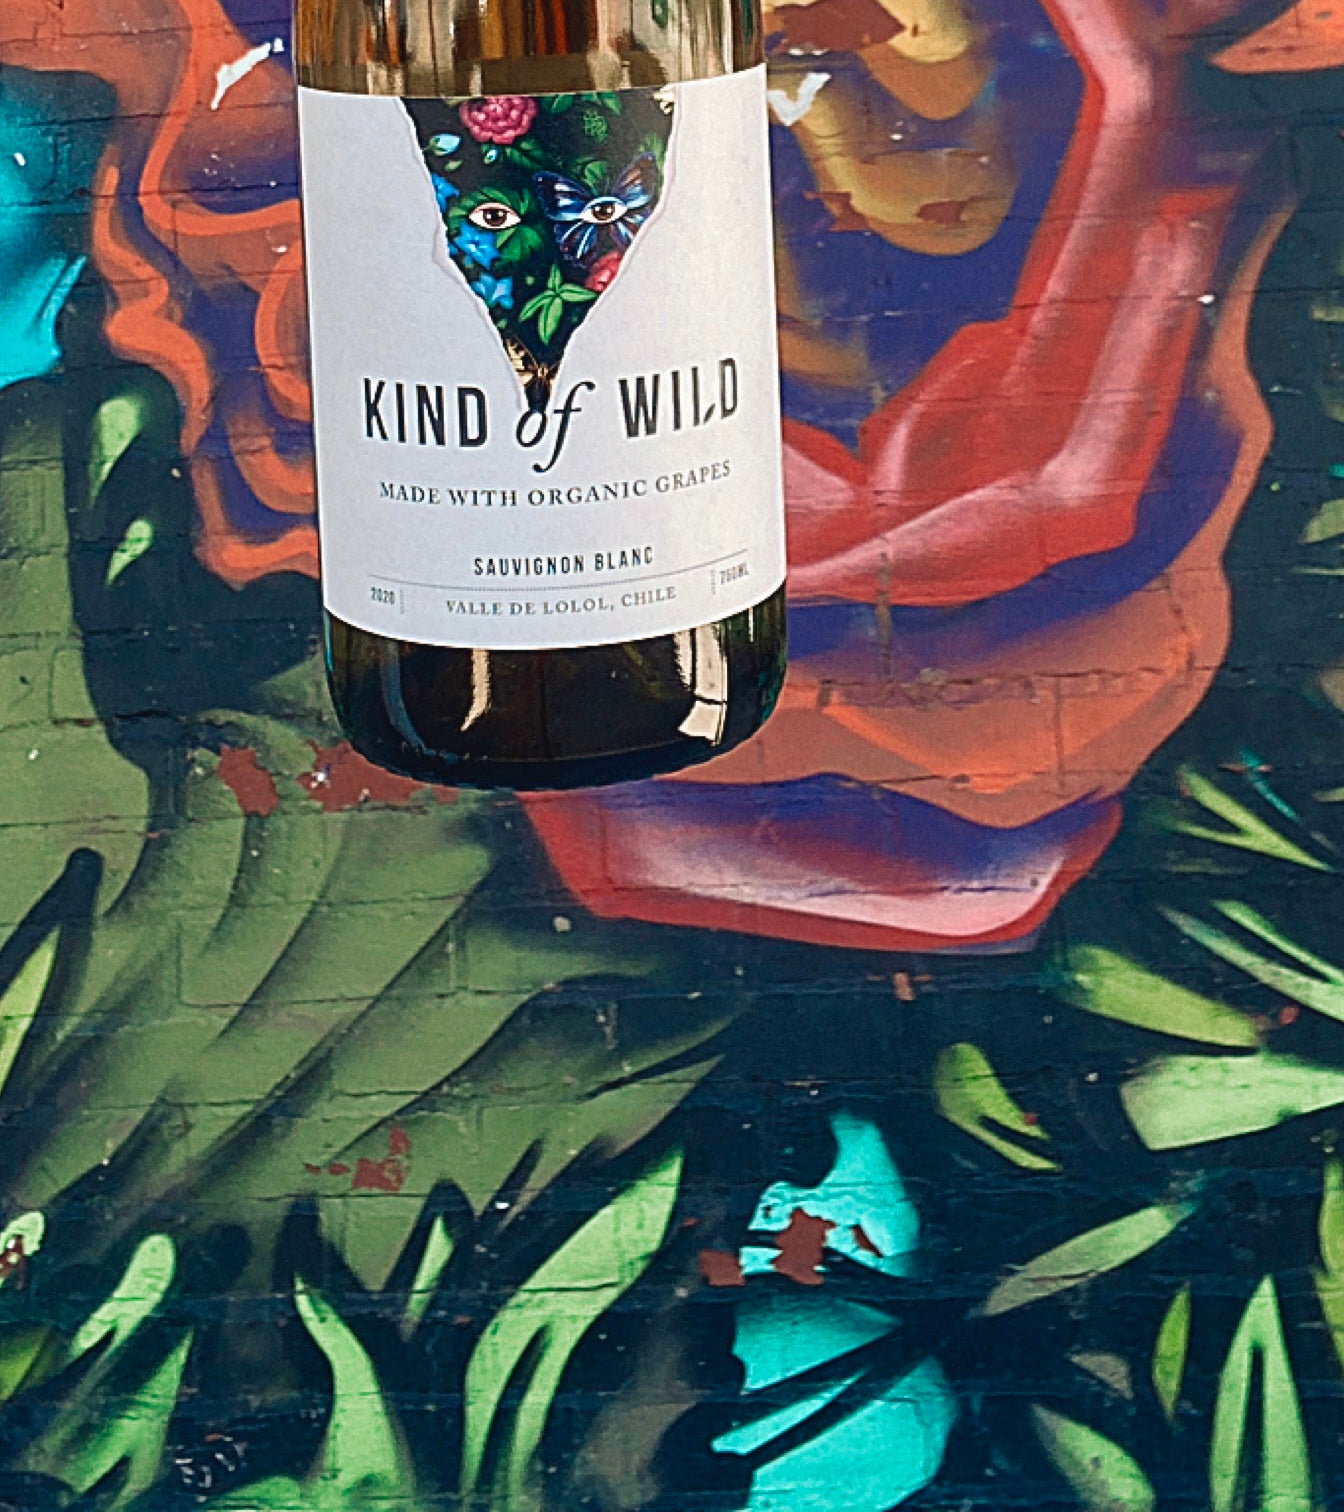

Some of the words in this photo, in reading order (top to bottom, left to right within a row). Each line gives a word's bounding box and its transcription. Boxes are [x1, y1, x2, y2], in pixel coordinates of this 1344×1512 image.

[364, 376, 488, 448] KIND
[516, 381, 595, 473] of
[619, 357, 739, 439] WILD
[380, 481, 441, 505] MADE
[447, 488, 518, 507] WITH
[528, 479, 648, 506] ORGANIC
[655, 460, 731, 493] GRAPES
[474, 555, 585, 576] SAUVIGNON
[594, 546, 654, 571] BLANC
[446, 599, 503, 615] VALLE
[509, 601, 536, 616] DE
[543, 597, 616, 615] LOLOL,
[620, 586, 677, 607] CHILE
